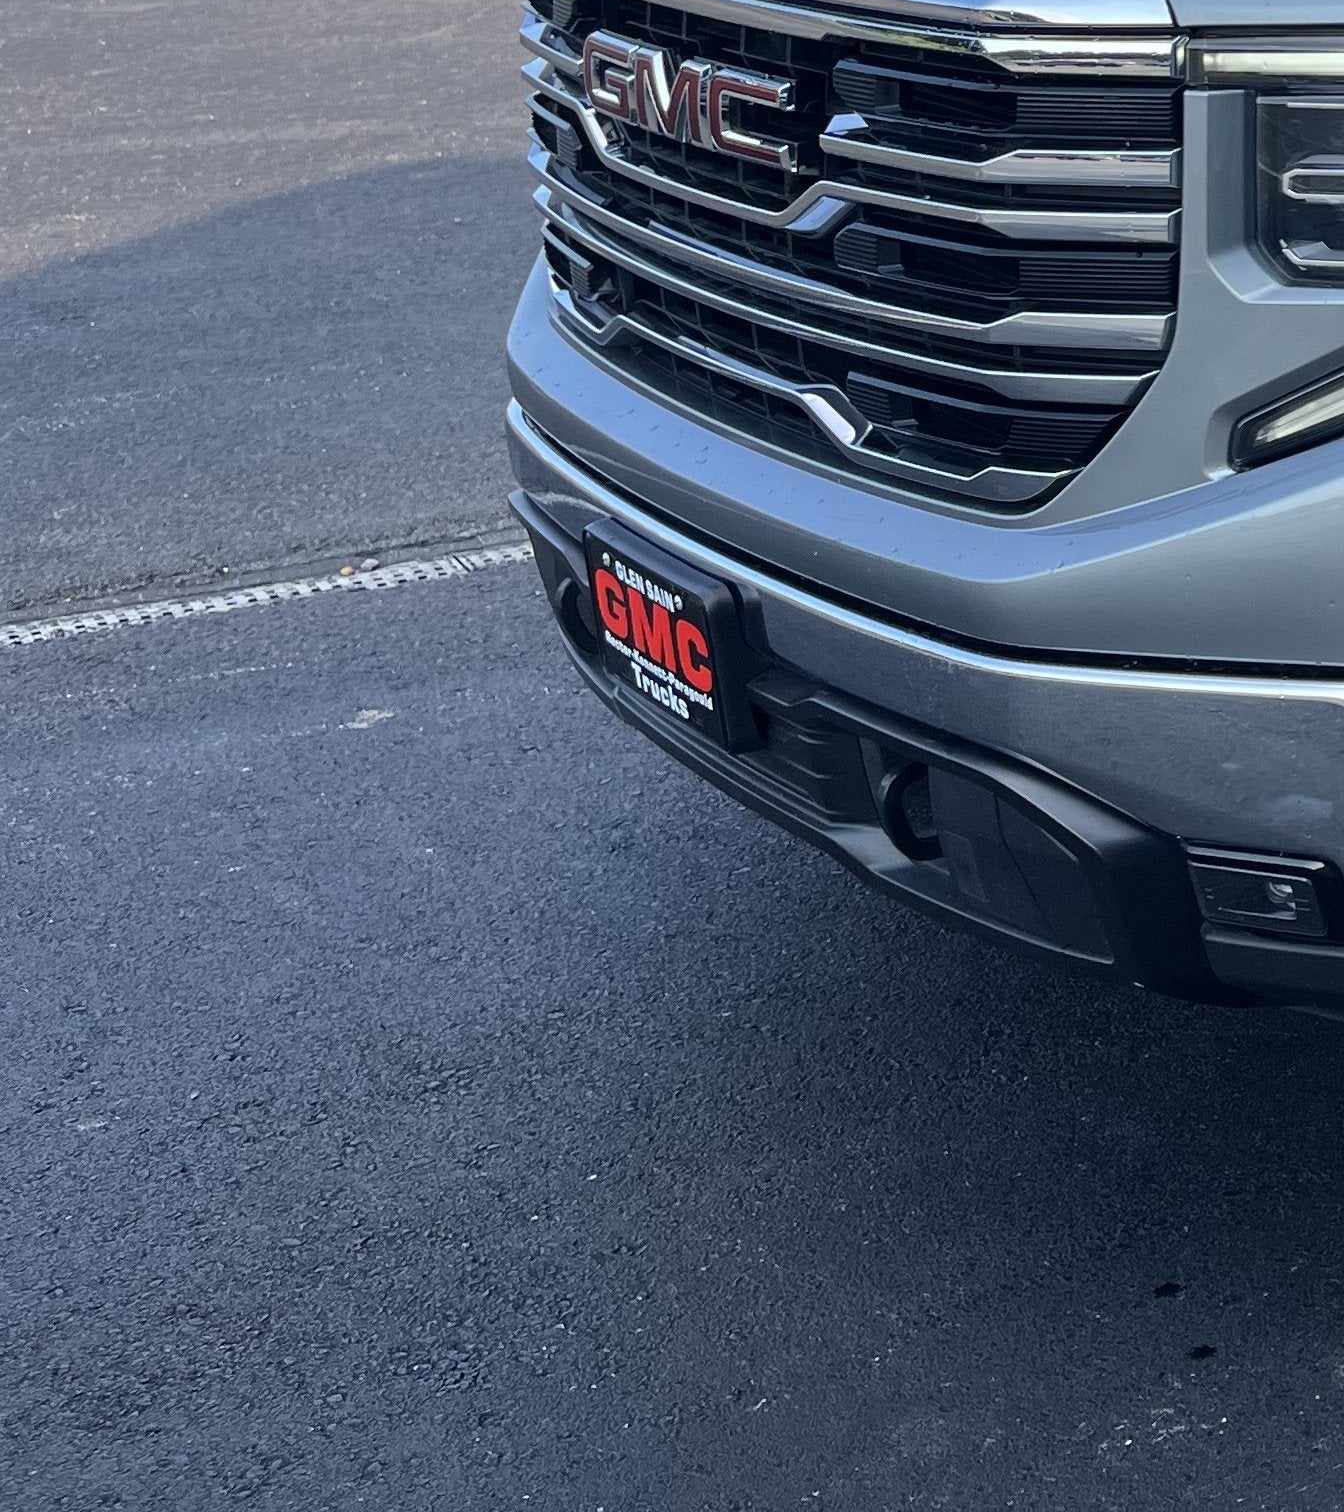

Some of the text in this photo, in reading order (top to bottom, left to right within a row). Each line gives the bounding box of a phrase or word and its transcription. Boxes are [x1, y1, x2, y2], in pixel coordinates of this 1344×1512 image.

[582, 28, 800, 174] GMC
[594, 568, 713, 693] GMC
[614, 560, 676, 613] GLEN SAIN
[630, 661, 690, 720] Trucks
